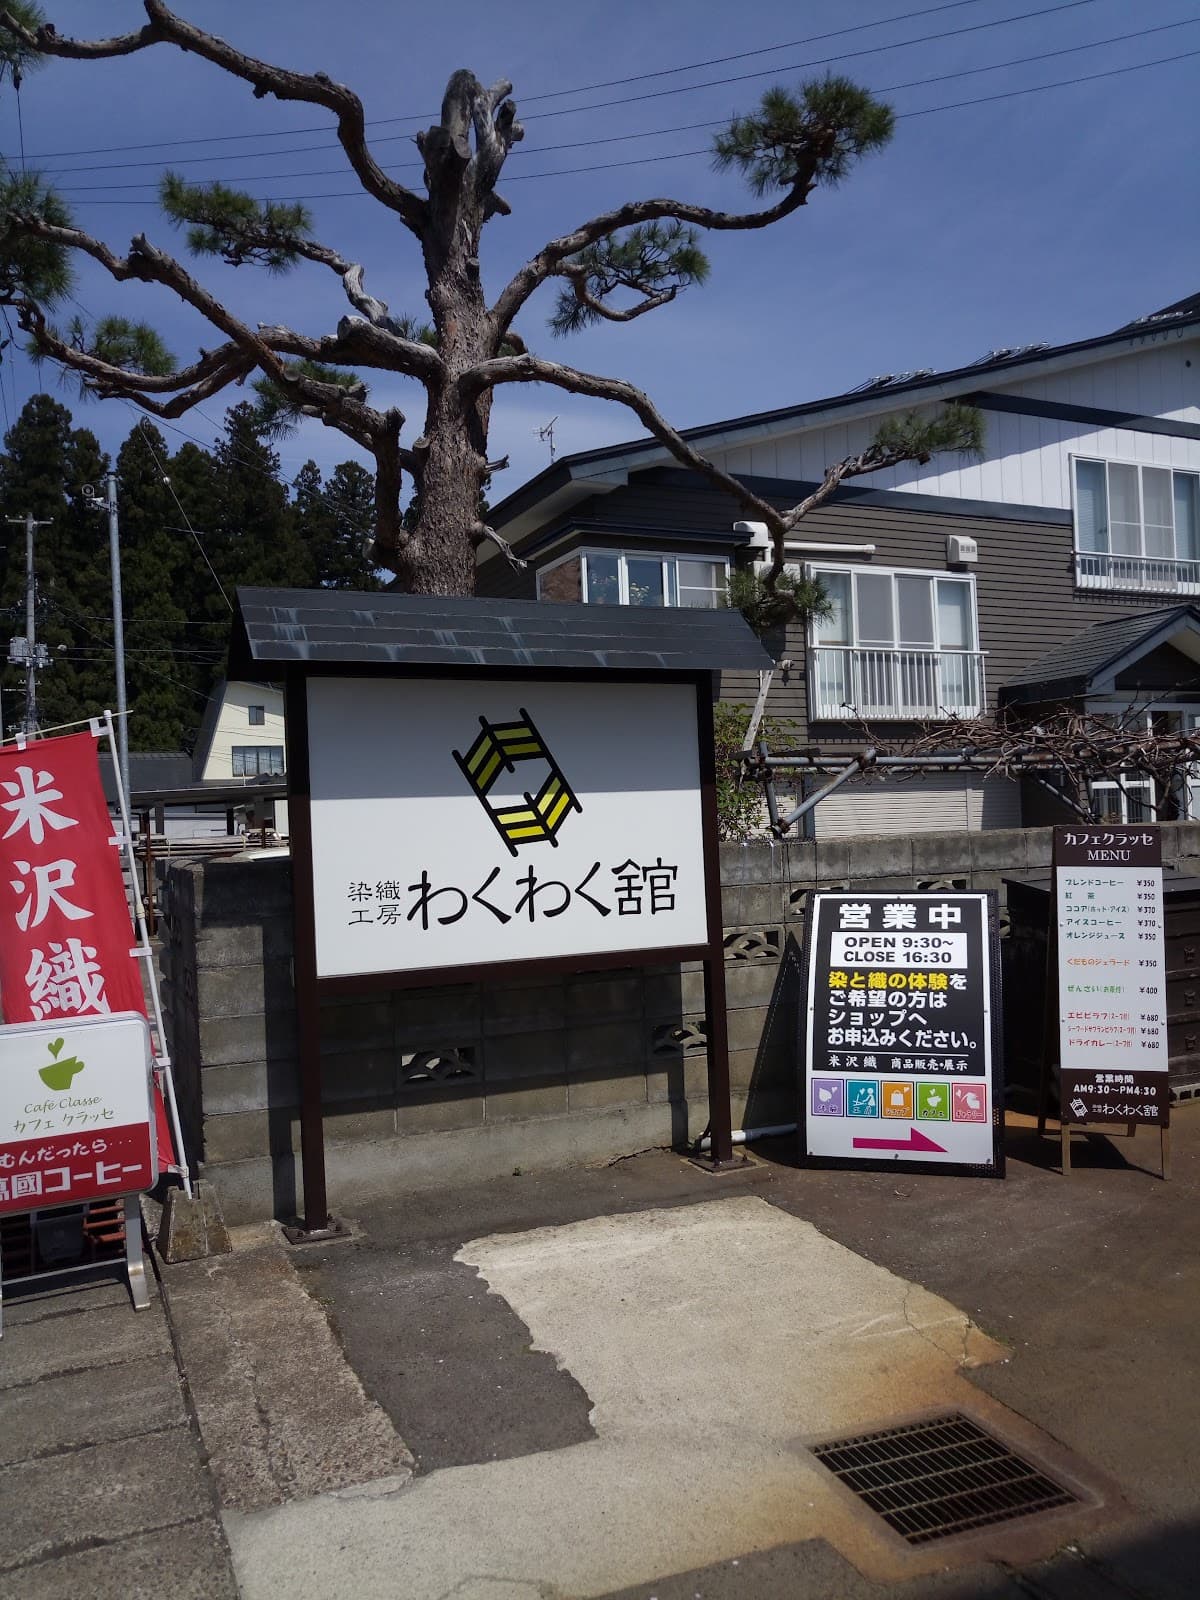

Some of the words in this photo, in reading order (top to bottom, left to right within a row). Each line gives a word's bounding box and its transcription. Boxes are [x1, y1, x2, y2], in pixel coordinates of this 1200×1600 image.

[1064, 832, 1153, 846] カフェクラッセ
[1087, 849, 1131, 861] MENU
[0, 766, 110, 1021] 米沢織
[347, 880, 401, 903] 染織
[347, 904, 401, 926] 工房
[838, 903, 962, 930] 営業中
[1066, 918, 1123, 927] アイスコーヒー
[844, 937, 896, 948] OPEN
[1066, 932, 1126, 941] オレンジジュース
[844, 951, 896, 963] CLOSE
[902, 952, 952, 963] 16:30
[828, 971, 968, 991] 染と織の体験を
[1139, 986, 1159, 995] ¥400
[829, 990, 948, 1009] ご希望の方は
[828, 1009, 928, 1026] ショップへ
[827, 1027, 977, 1049] お申込みください。
[828, 1055, 878, 1069] 米沢織
[1095, 1073, 1135, 1084] 営業時間
[59, 1095, 103, 1109] Classe
[14, 1118, 55, 1133] カフェ
[62, 1108, 115, 1126] クラッセ
